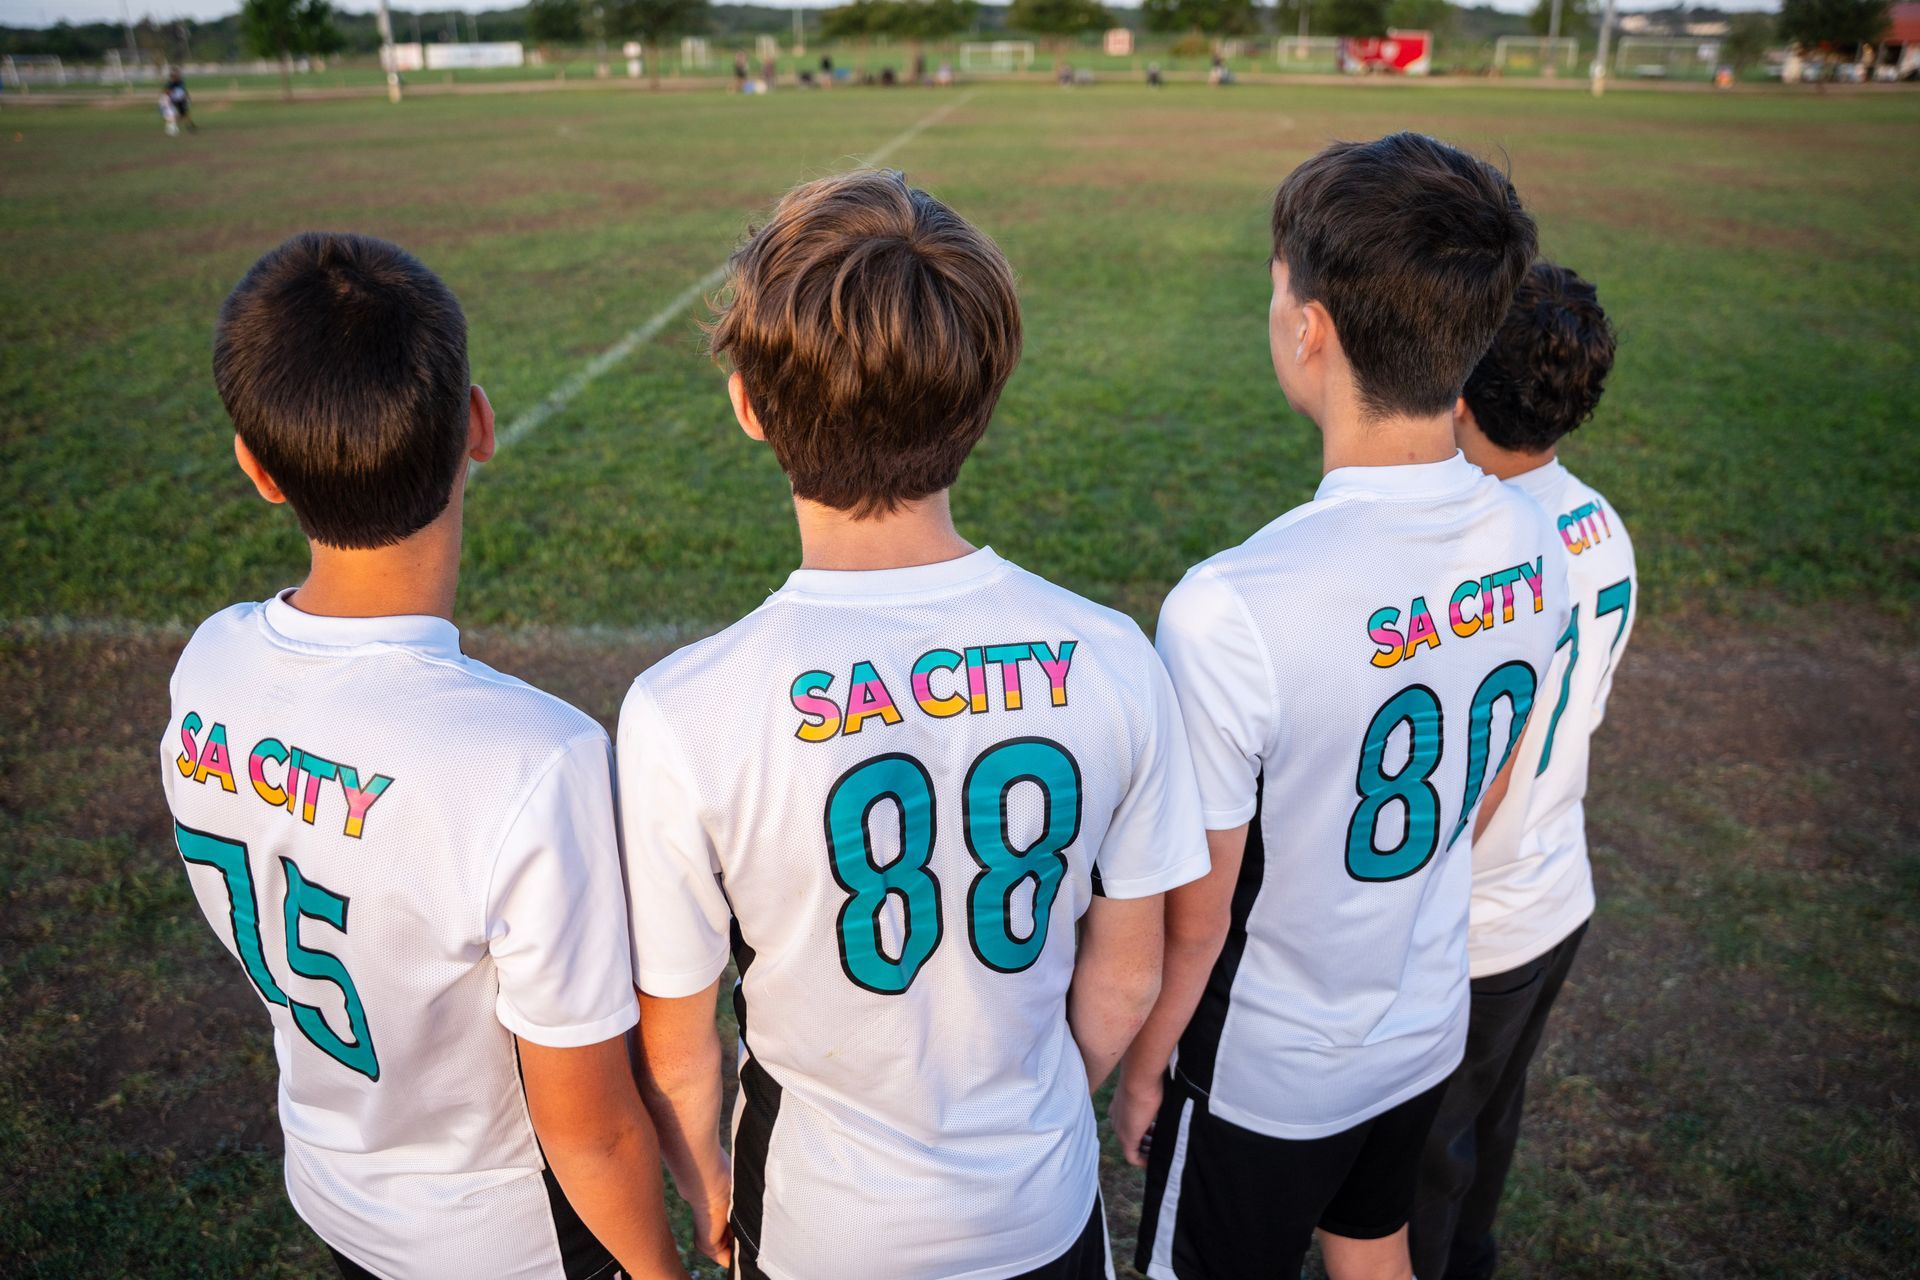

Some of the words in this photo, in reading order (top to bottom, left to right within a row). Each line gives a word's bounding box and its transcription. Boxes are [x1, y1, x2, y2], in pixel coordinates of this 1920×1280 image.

[1557, 499, 1612, 555] CITY
[1367, 596, 1441, 668] SA
[1449, 555, 1543, 638] CITY
[790, 660, 904, 743] SA
[911, 641, 1078, 718] CITY
[1535, 577, 1632, 779] 17
[176, 711, 238, 794] SA
[248, 737, 395, 839] CITY
[824, 736, 1083, 995] 88
[174, 816, 380, 1082] 75
